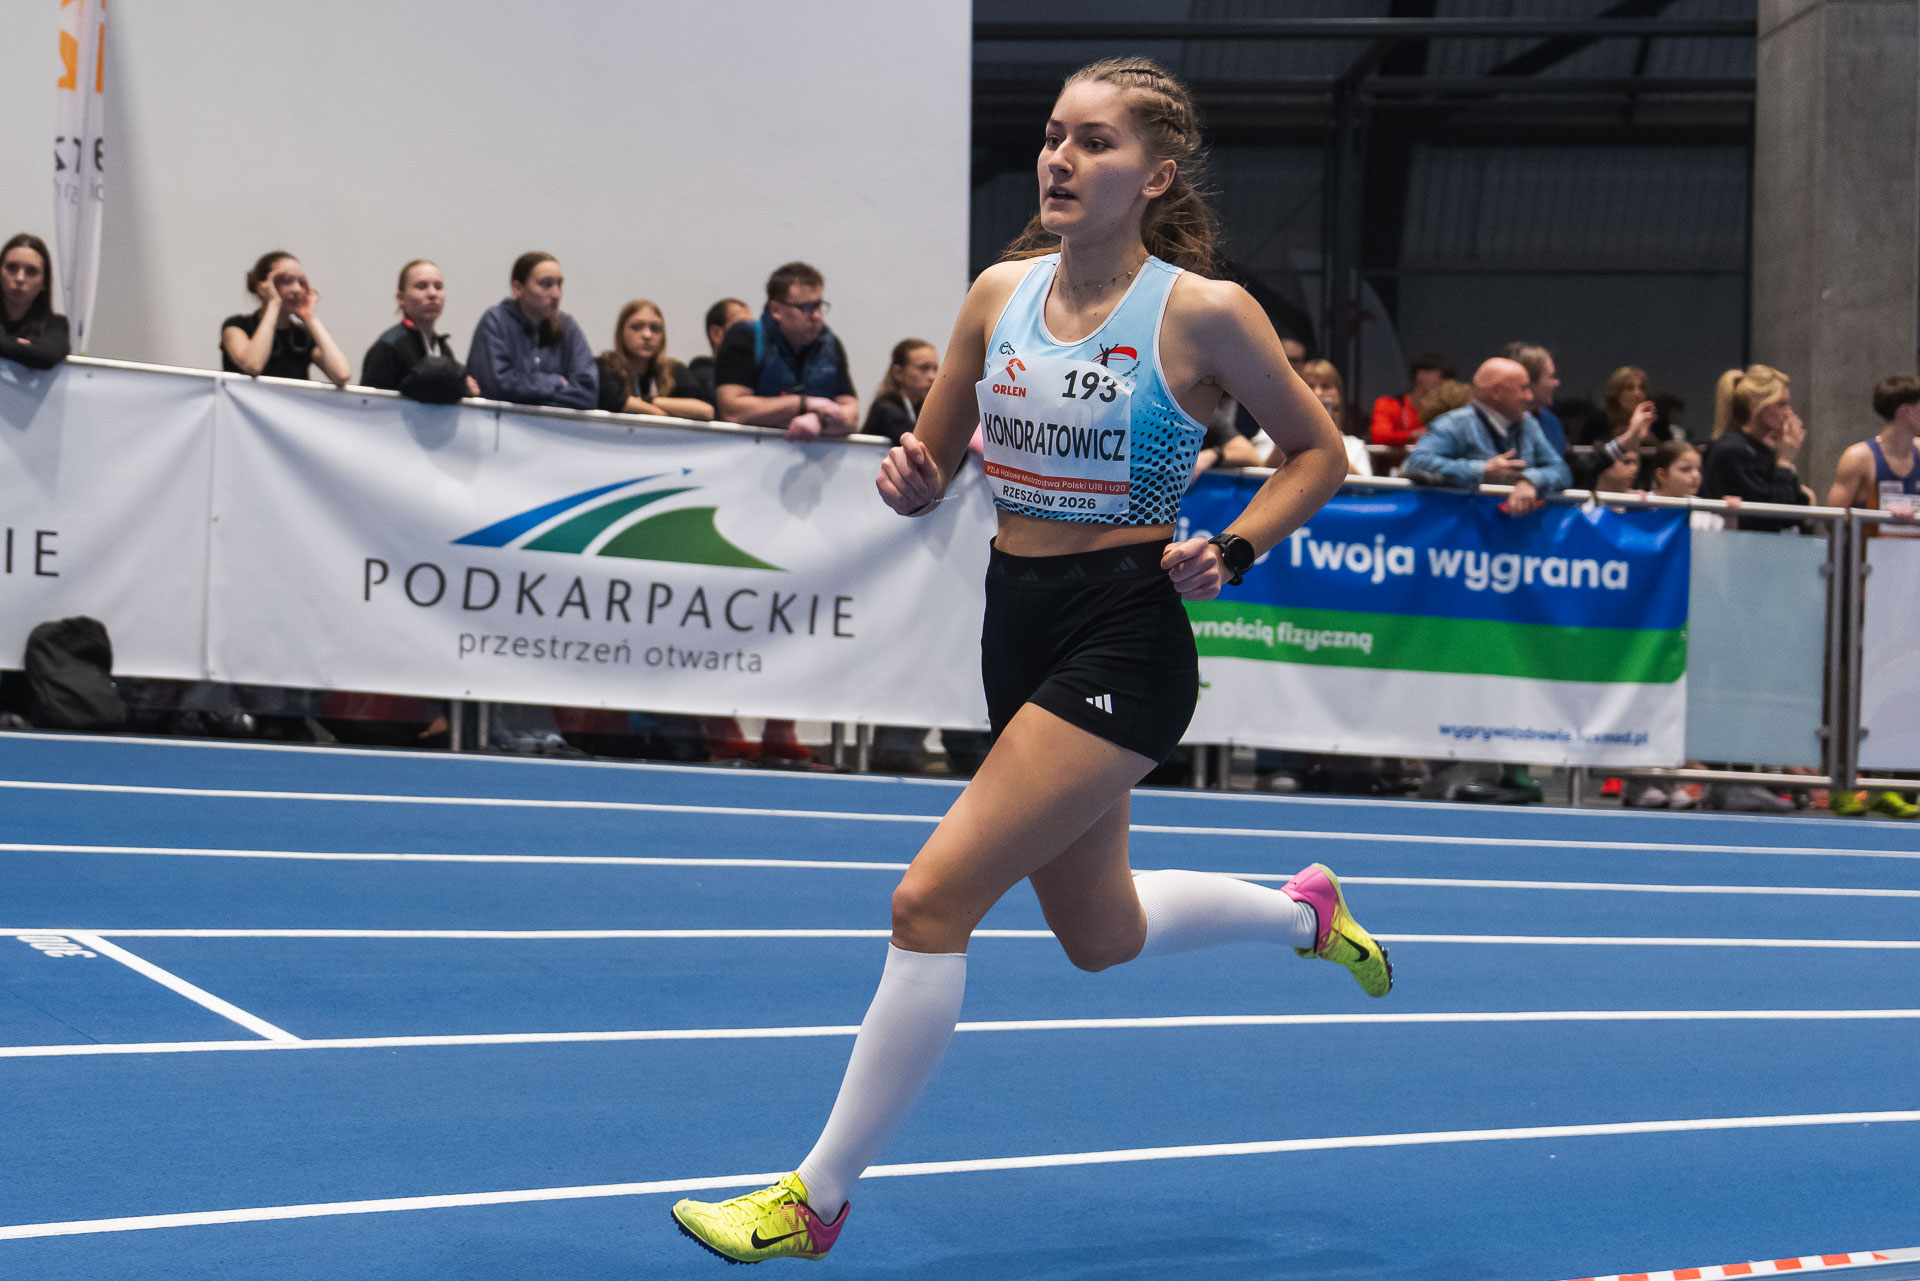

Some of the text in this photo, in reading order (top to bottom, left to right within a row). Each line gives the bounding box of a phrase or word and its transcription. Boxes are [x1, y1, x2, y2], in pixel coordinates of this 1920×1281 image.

[992, 383, 1027, 398] ORLEN
[1062, 369, 1118, 402] 193
[984, 411, 1126, 462] KONDRATOWICZ
[987, 464, 1000, 475] PZLA
[1001, 469, 1021, 481] Halowe
[1062, 481, 1087, 490] Polski
[1088, 483, 1103, 491] U18
[1109, 484, 1127, 492] U20
[1003, 485, 1097, 510] RZESZÓW 2026
[1289, 526, 1629, 593] Twoja wygrana
[363, 557, 857, 638] PODKARPACKIE
[458, 629, 763, 674] przestrzeń otwarta
[1277, 621, 1374, 655] fizyczną
